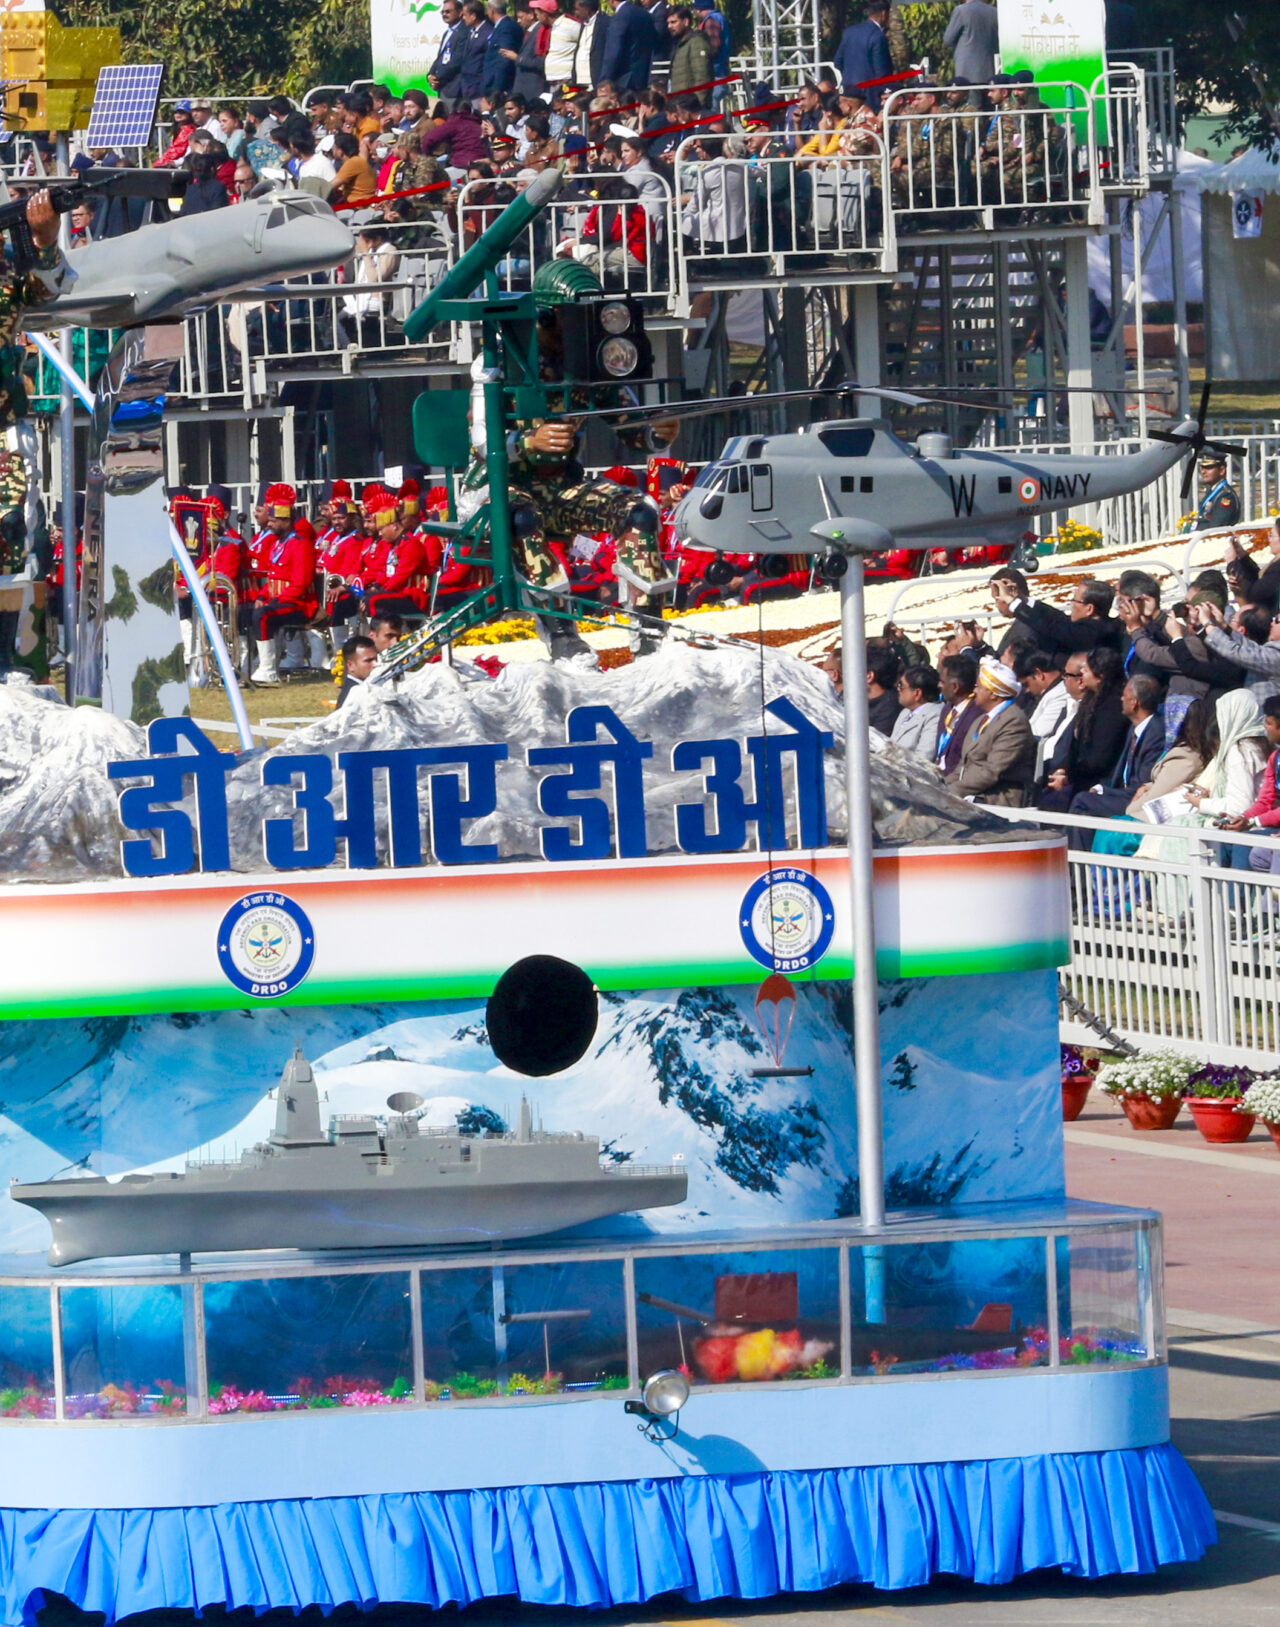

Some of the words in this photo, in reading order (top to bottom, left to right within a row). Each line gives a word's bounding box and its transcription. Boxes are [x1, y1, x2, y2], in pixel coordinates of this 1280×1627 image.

[948, 473, 976, 518] W
[1039, 472, 1091, 501] NAVY
[107, 715, 235, 877] डी
[526, 704, 653, 862] डी
[669, 694, 834, 853] ओ
[774, 956, 808, 970] DRDO
[251, 981, 288, 995] DRDO
